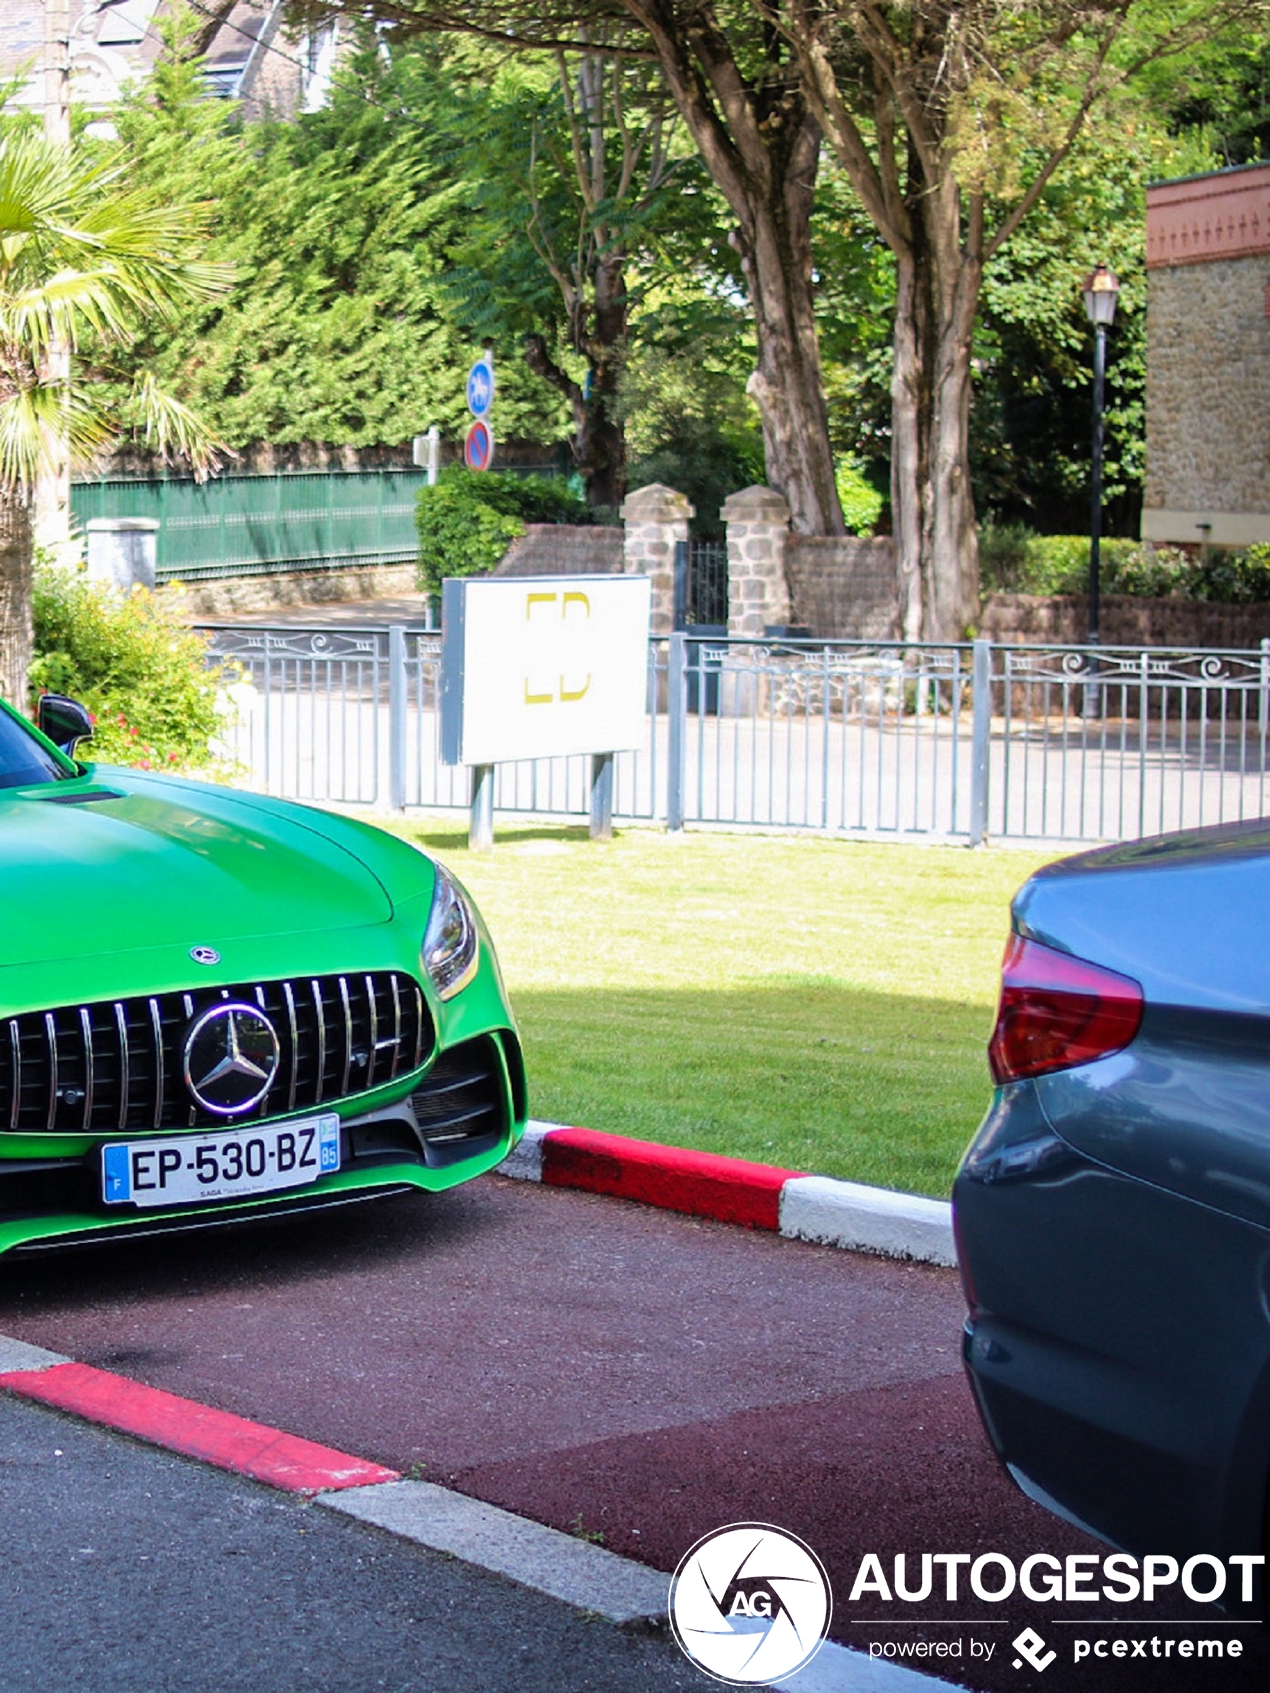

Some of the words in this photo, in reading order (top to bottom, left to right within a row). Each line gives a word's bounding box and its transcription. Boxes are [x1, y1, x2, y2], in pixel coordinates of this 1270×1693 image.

[132, 1128, 317, 1191] EP-530-BZ
[321, 1145, 337, 1166] 85
[113, 1178, 122, 1191] F
